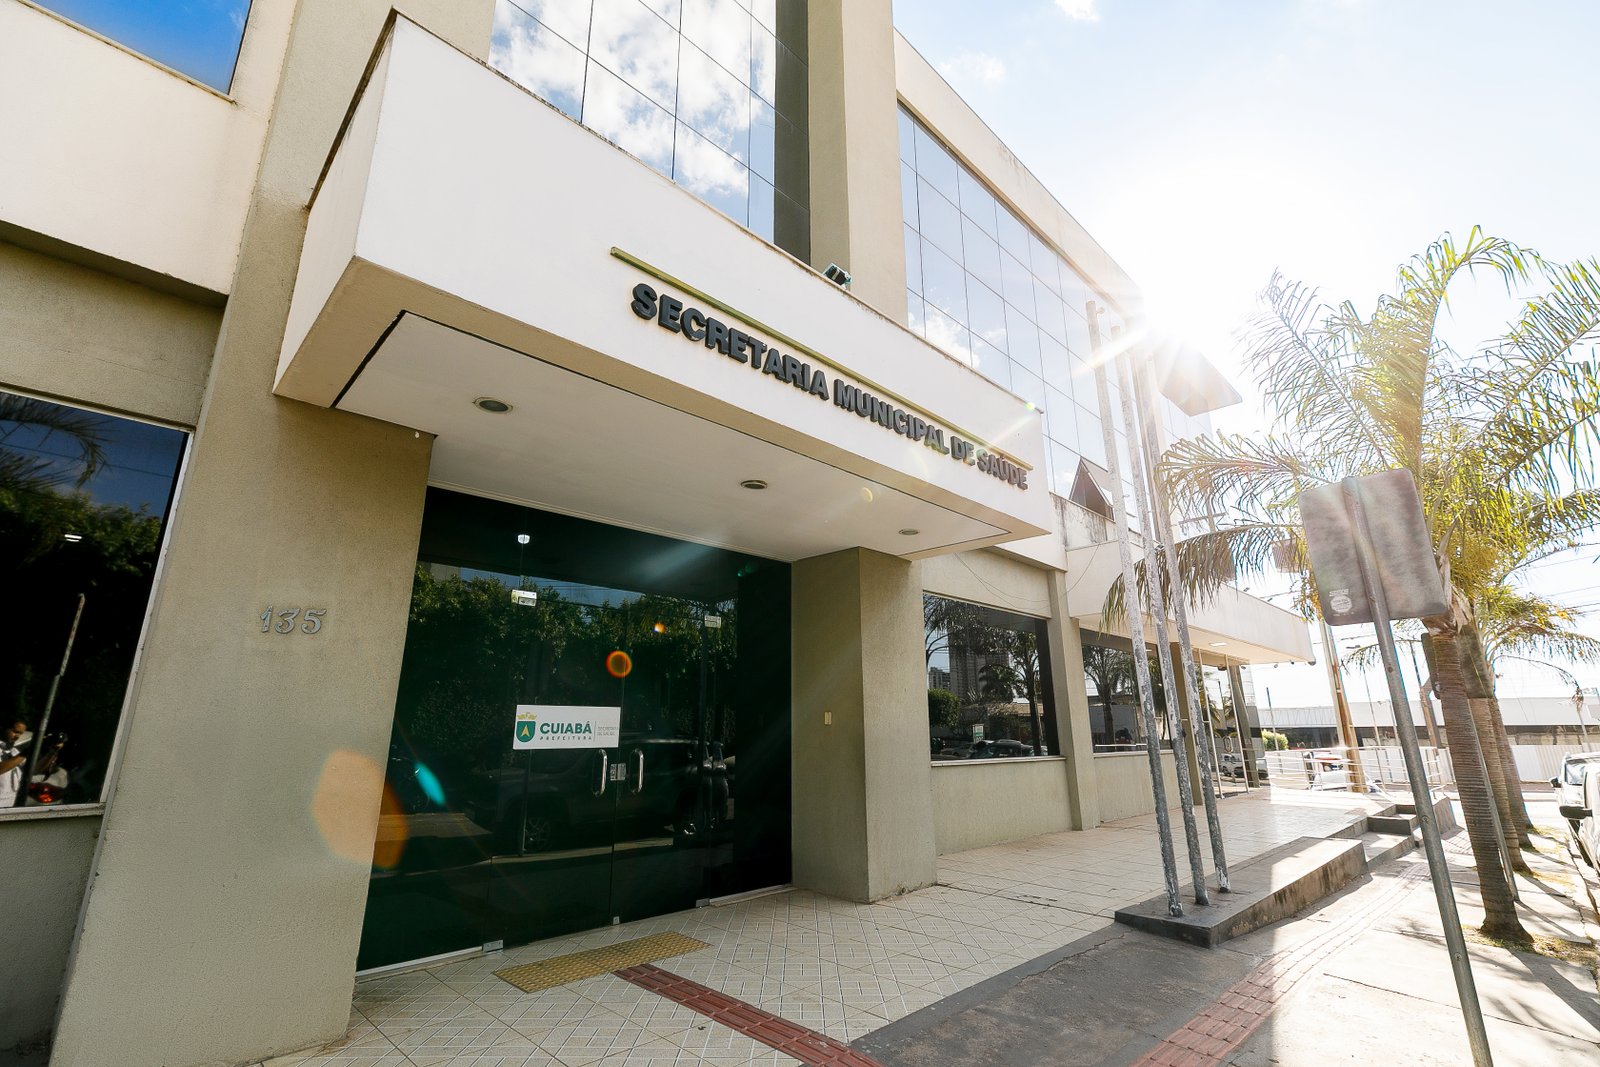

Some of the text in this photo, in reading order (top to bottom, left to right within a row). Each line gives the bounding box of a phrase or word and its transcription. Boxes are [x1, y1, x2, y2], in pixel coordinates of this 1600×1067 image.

[631, 283, 1029, 491] SECRETARIA MUNICIPAL DE SAÚDE
[260, 605, 327, 634] 135
[540, 720, 592, 735] CUIABÁ
